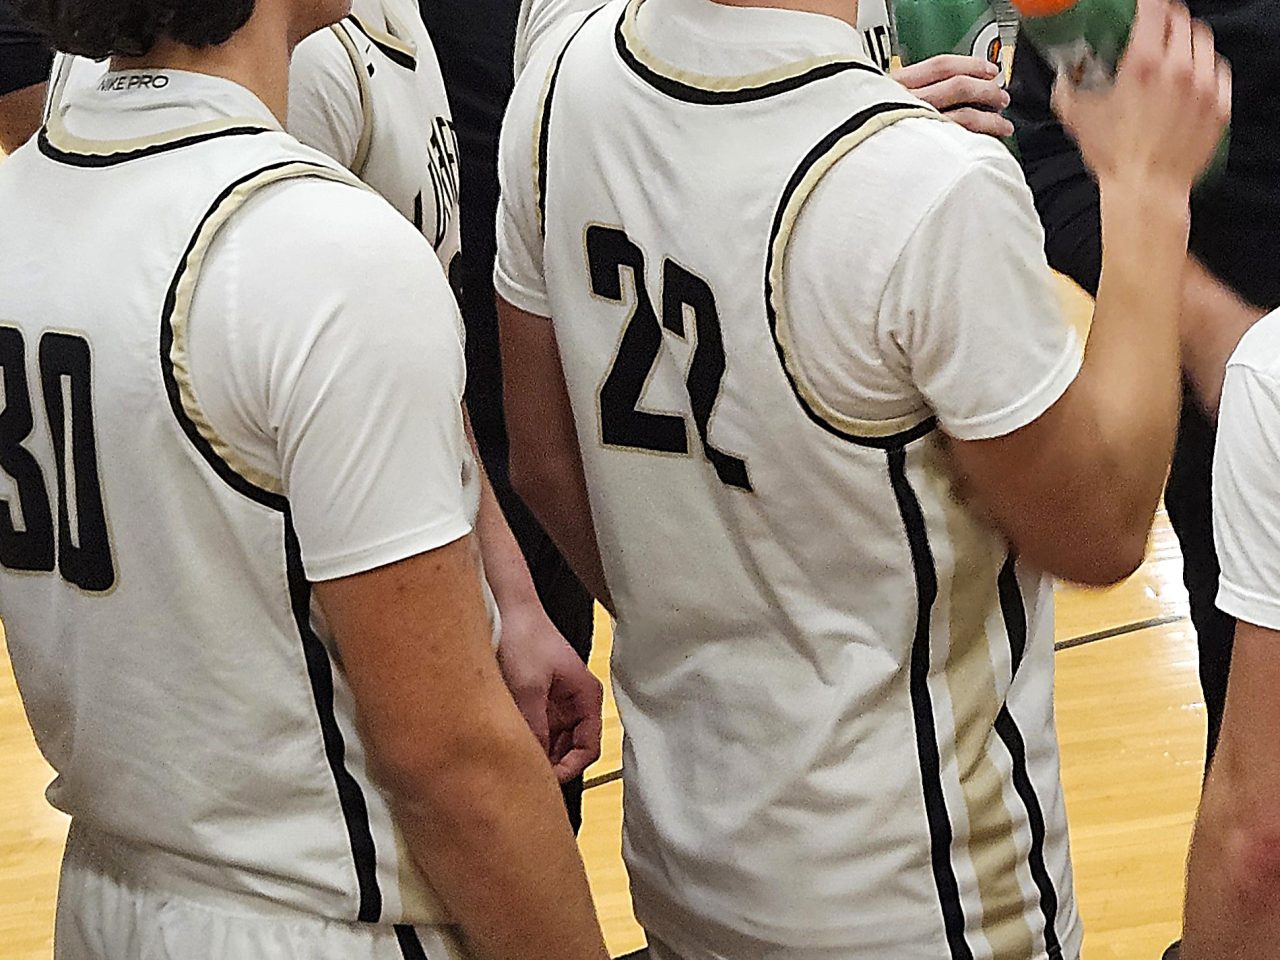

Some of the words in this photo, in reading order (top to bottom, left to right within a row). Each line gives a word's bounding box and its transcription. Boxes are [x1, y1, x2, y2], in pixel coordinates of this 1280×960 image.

[127, 74, 169, 89] PRO
[0, 320, 120, 596] 30
[583, 221, 755, 492] 22
